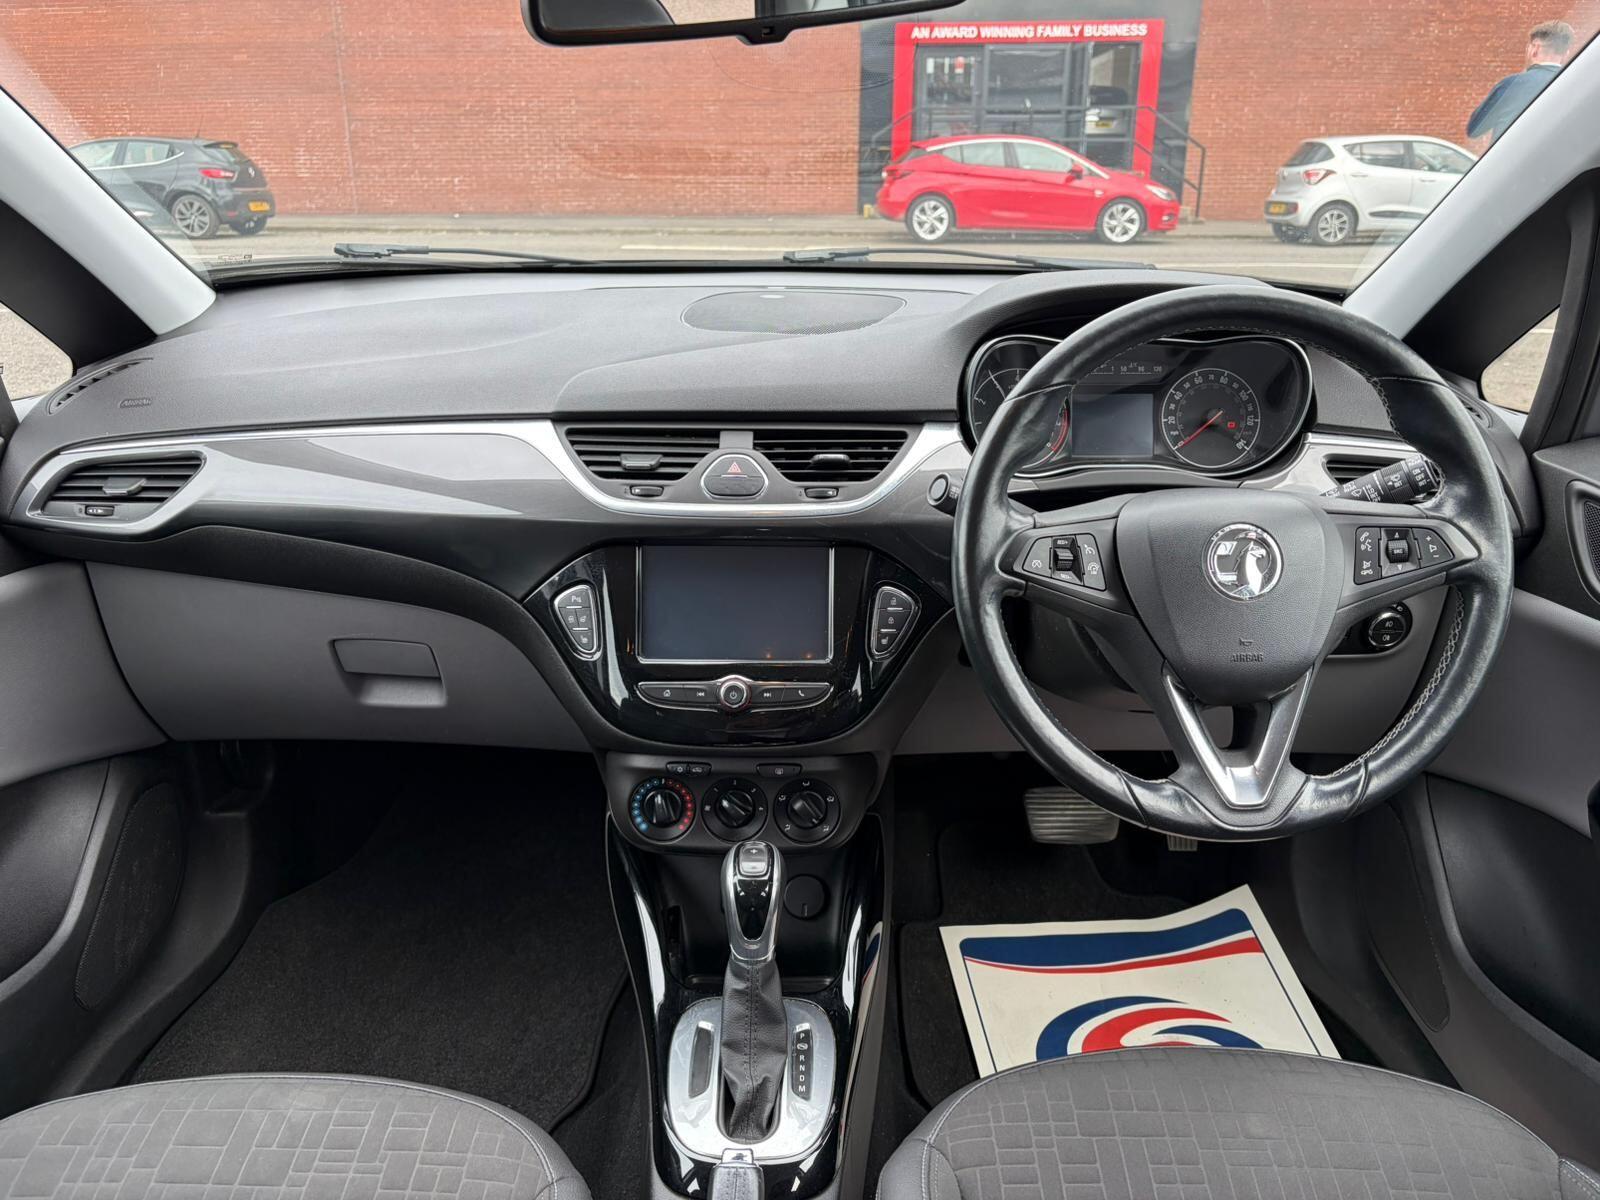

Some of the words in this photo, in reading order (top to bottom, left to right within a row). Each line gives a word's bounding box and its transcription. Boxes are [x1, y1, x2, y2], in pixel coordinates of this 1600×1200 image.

[911, 26, 930, 38] AN
[931, 26, 978, 38] AWARD
[980, 26, 1034, 38] WINNING
[1037, 25, 1081, 37] FAMILY
[1083, 24, 1147, 36] BUSINESS
[1167, 415, 1176, 425] 20
